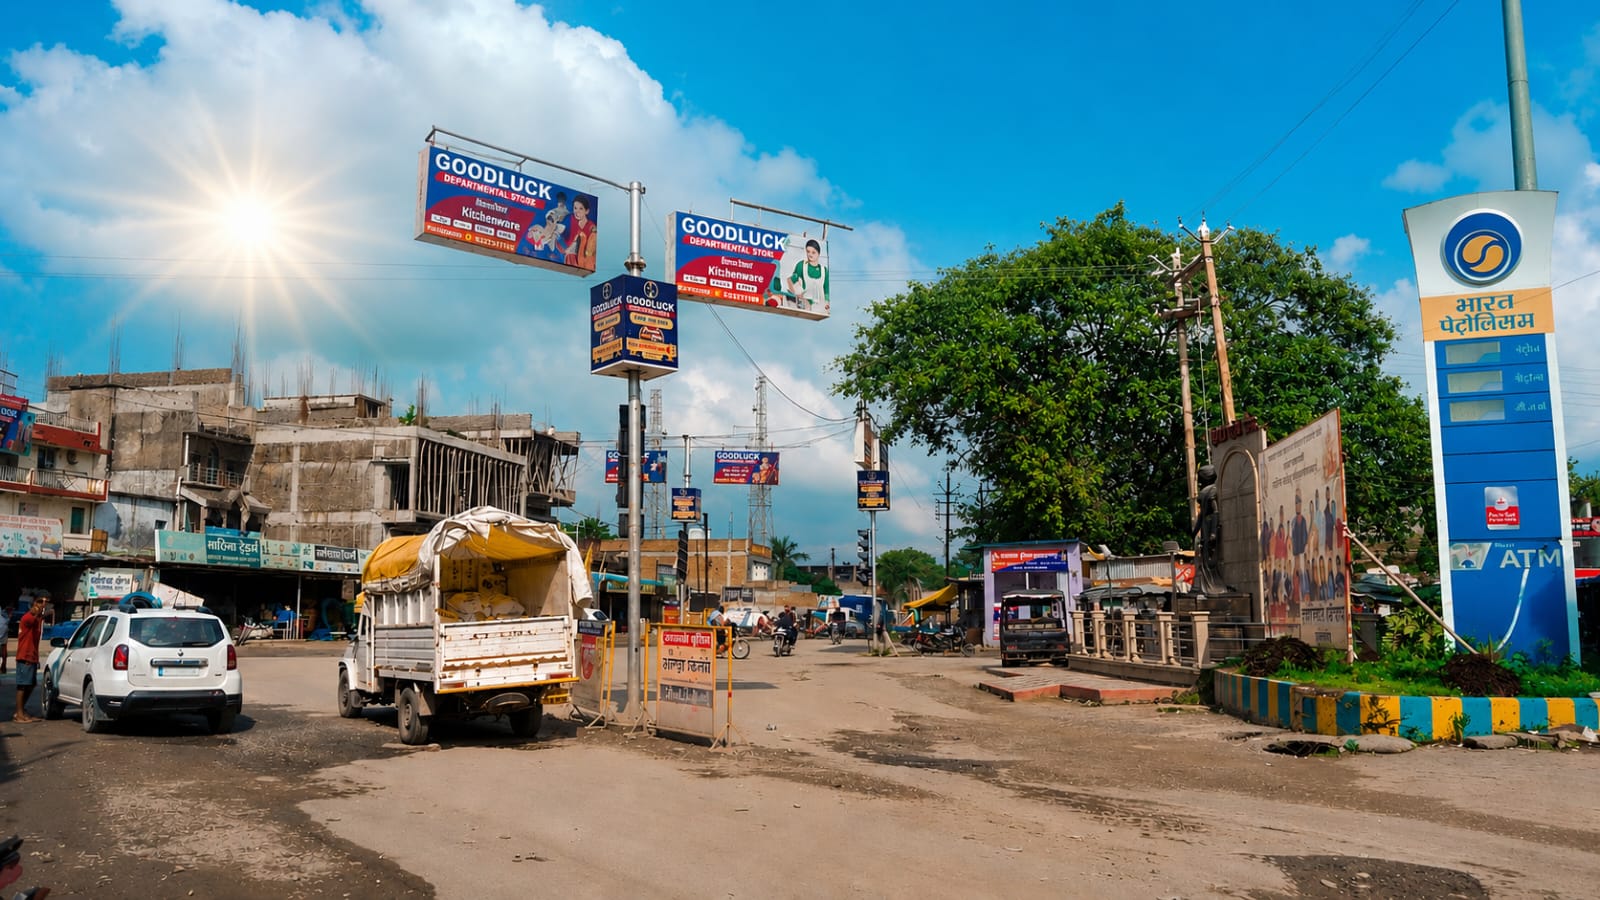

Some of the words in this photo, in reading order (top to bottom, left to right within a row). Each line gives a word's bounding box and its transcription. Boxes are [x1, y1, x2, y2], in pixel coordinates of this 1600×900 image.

[435, 152, 552, 201] GOODLUCK
[461, 206, 521, 231] Kitchenware
[681, 217, 786, 251] GOODLUCK
[708, 265, 764, 283] Kitchenware
[625, 294, 675, 312] GOODLUCK
[1456, 293, 1514, 313] भारत
[716, 451, 761, 460] GOODLUCK
[1499, 548, 1561, 569] ATM
